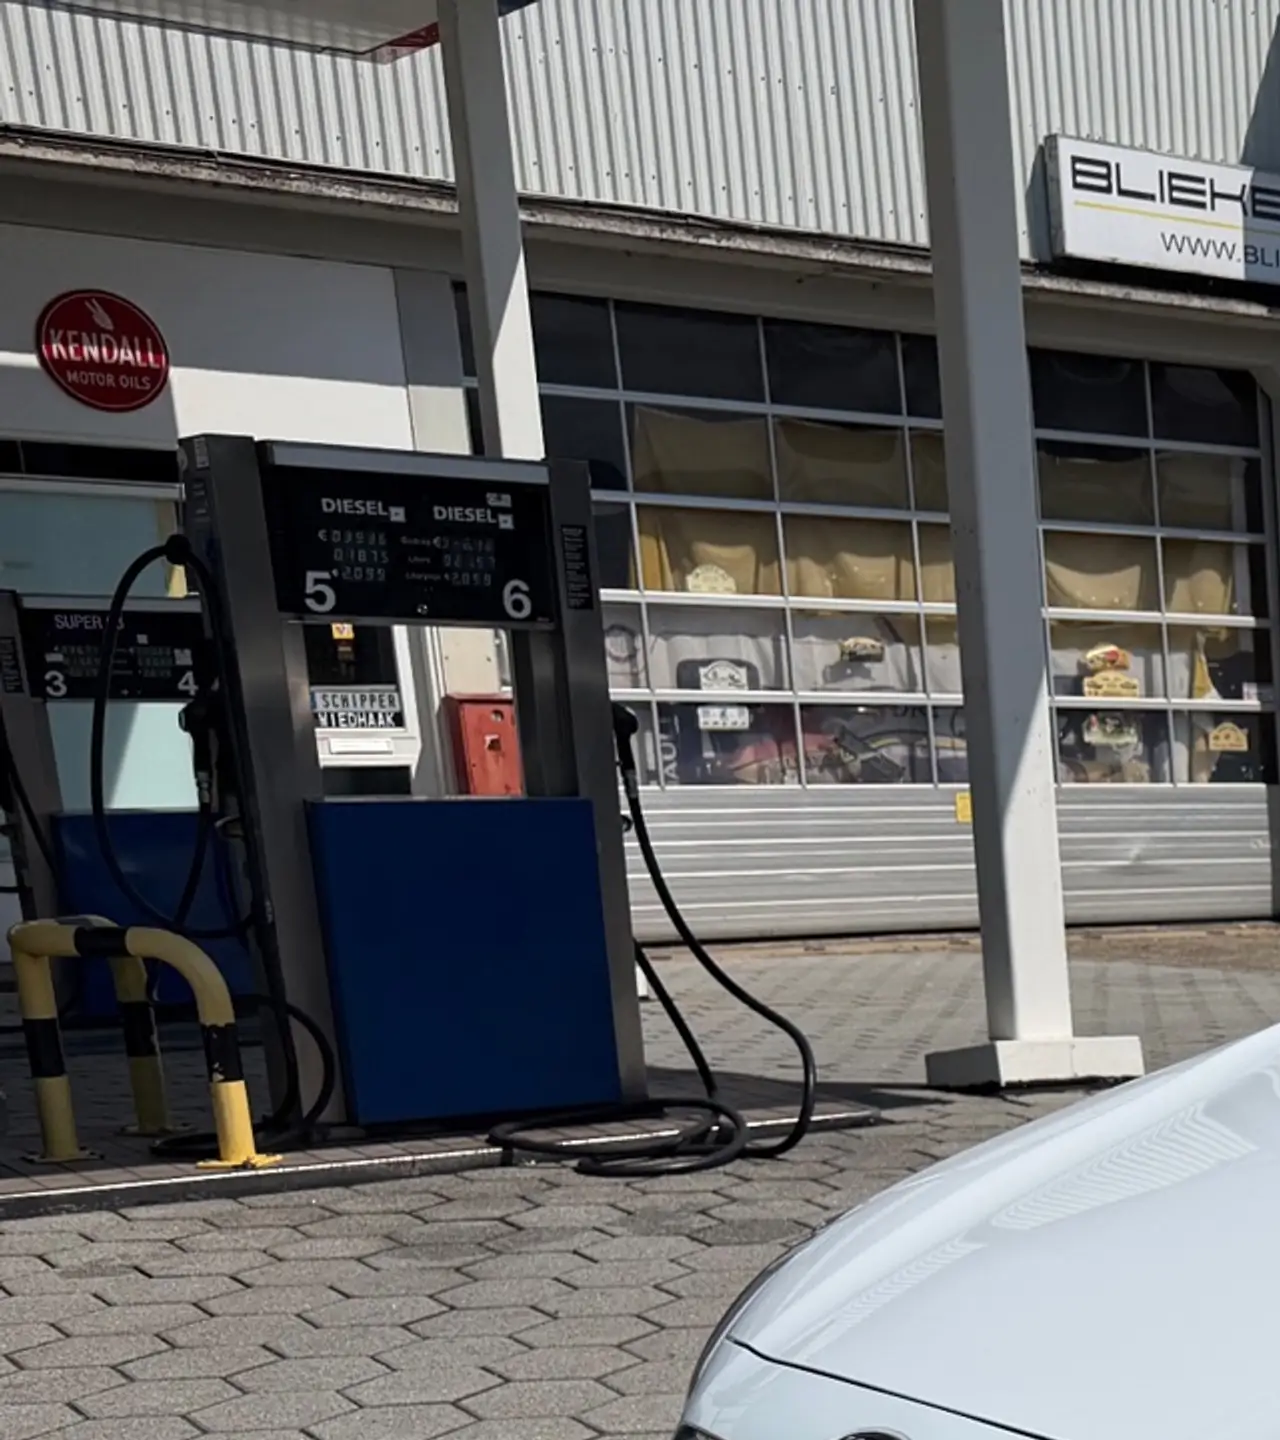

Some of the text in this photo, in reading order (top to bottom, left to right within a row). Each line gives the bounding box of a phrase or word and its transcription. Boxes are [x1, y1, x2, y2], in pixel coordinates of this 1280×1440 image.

[50, 329, 161, 369] KENDALL
[67, 370, 151, 390] MOTOR OILS
[321, 497, 497, 524] DIESEL DIESEL
[304, 570, 337, 613] 5
[502, 578, 532, 619] 6
[54, 614, 103, 630] SUPER
[44, 670, 68, 697] 3
[177, 670, 198, 696] 4
[322, 693, 397, 709] SCHIPPER
